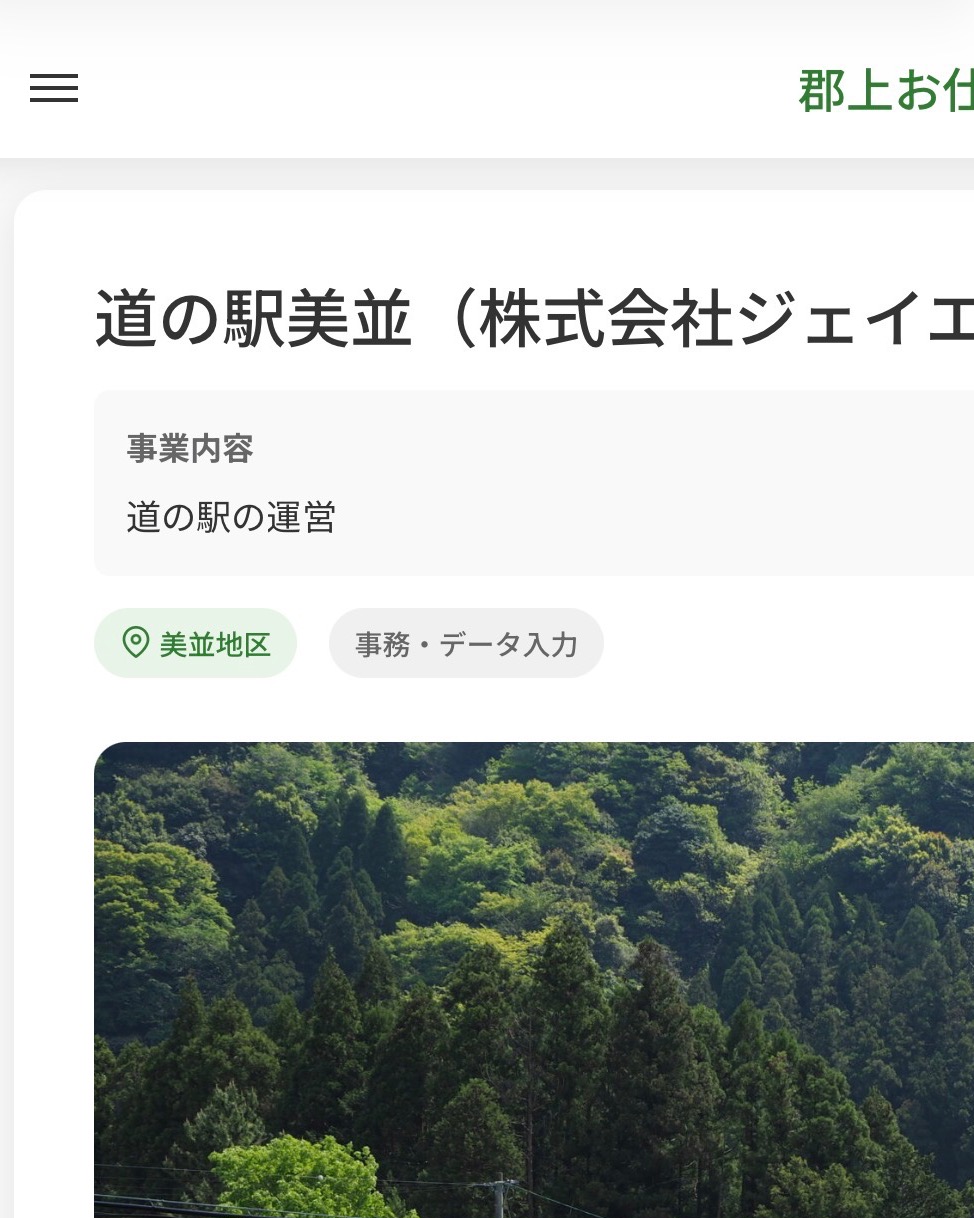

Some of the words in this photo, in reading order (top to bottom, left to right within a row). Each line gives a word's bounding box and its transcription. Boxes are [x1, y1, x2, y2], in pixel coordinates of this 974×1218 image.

[126, 432, 254, 464] 事業内容
[126, 499, 336, 534] 道の駅の運営
[160, 630, 271, 659] 美並地区
[355, 630, 577, 659] 事務・データ入力
